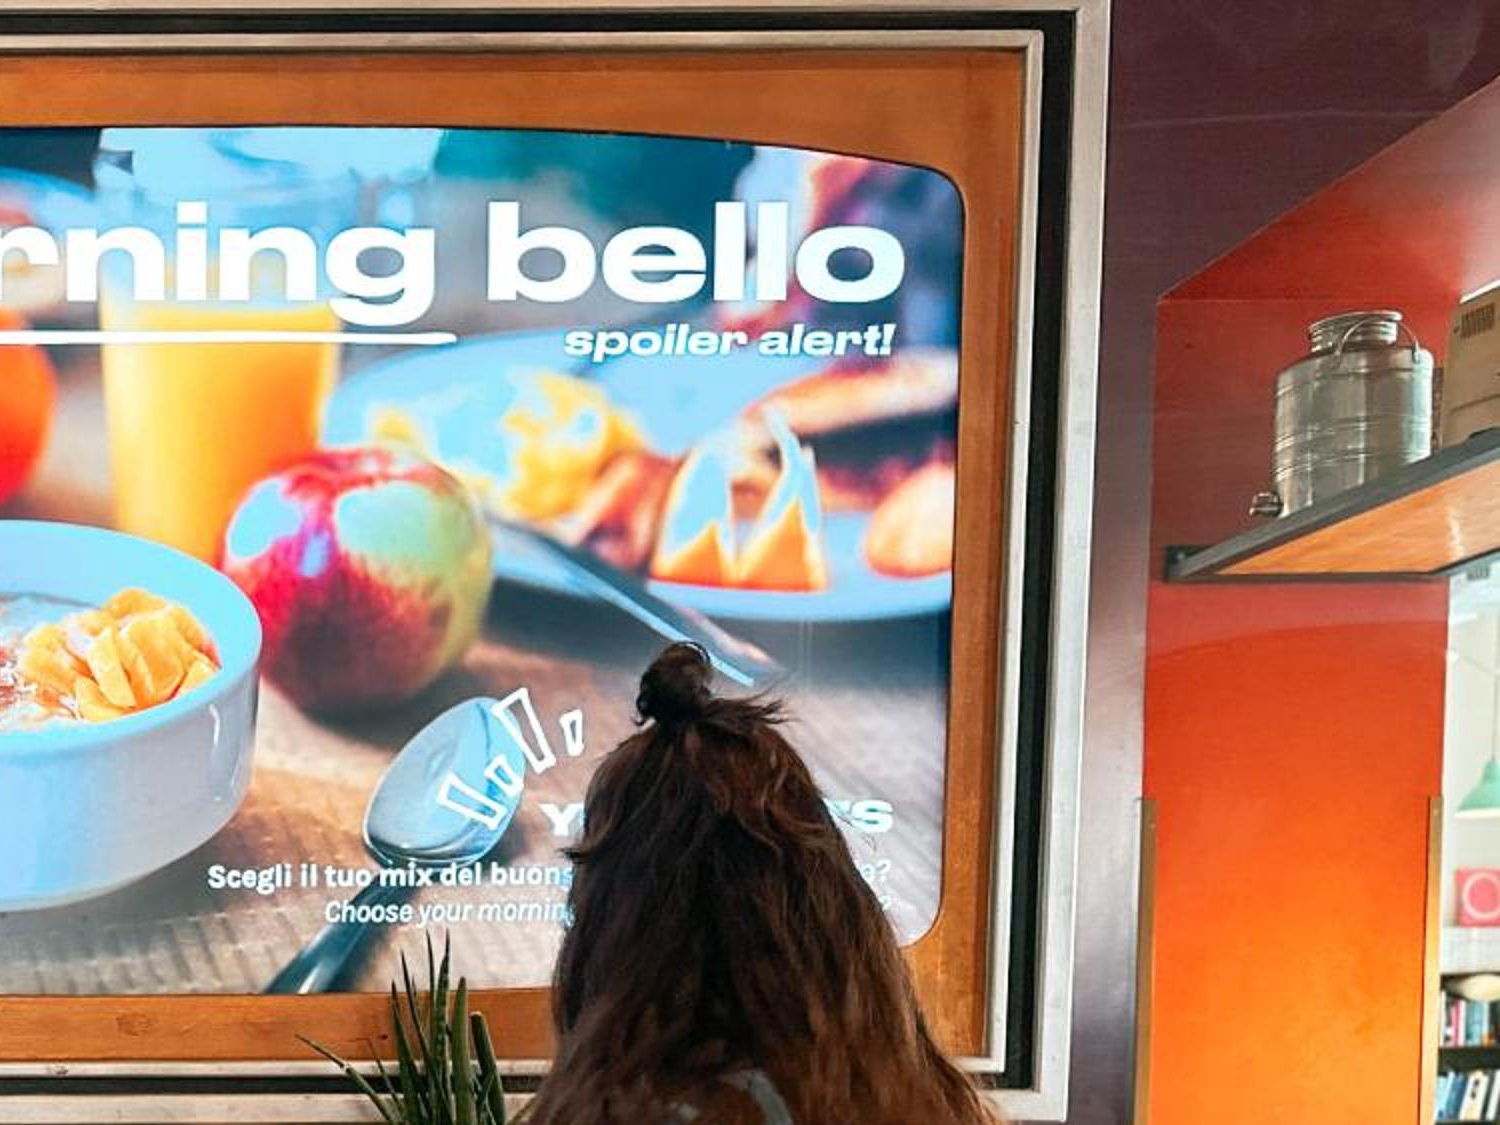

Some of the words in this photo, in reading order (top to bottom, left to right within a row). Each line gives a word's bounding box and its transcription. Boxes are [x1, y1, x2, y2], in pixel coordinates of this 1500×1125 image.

[488, 201, 905, 303] bello
[564, 324, 747, 363] spoiler
[758, 324, 896, 357] alert!
[207, 863, 292, 895] Scegli
[301, 864, 318, 887] il
[325, 868, 372, 888] tuo
[380, 862, 433, 888] mix
[440, 863, 482, 887] del
[324, 900, 412, 924] Choose
[418, 905, 471, 928] your
